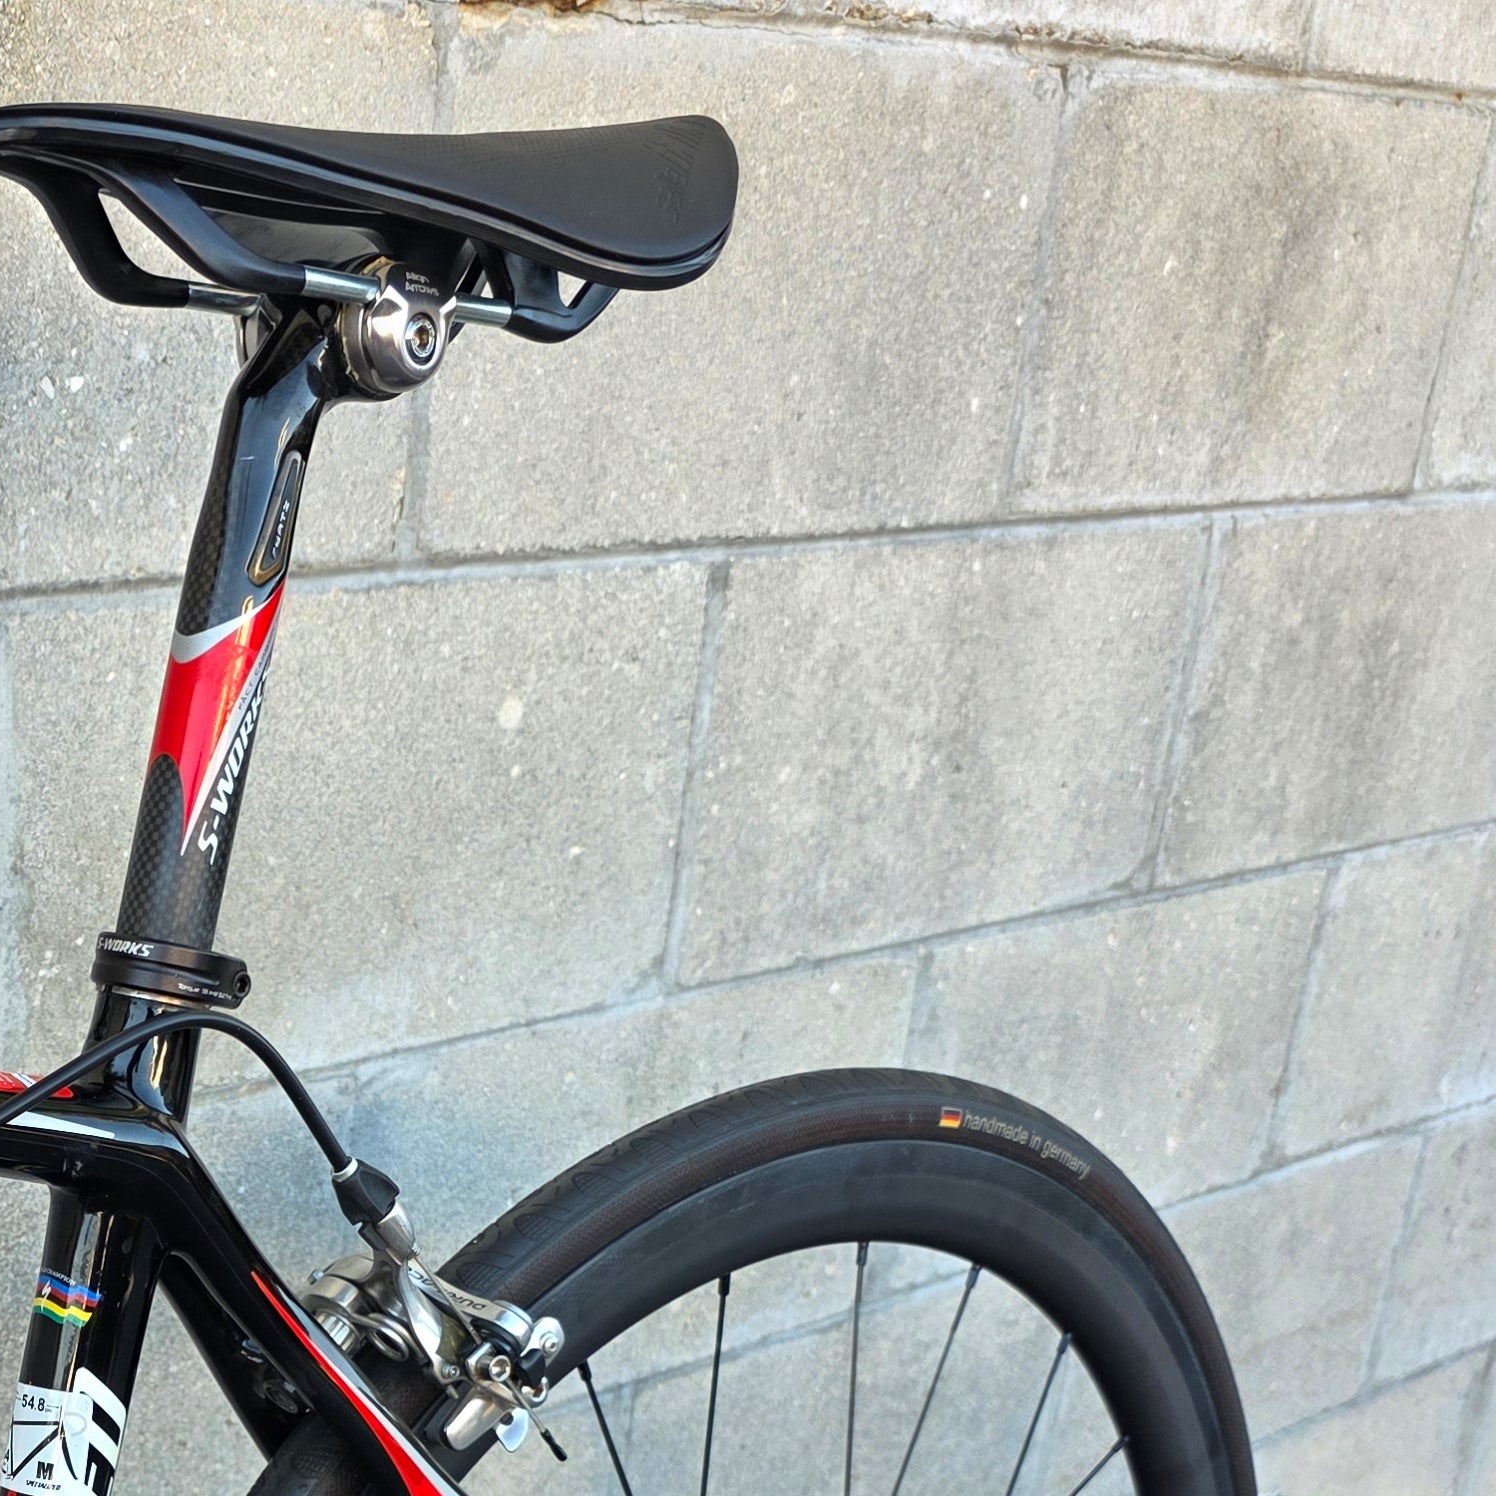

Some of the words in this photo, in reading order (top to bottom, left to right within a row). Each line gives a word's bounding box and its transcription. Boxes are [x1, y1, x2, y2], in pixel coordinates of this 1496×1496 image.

[98, 937, 154, 957] S-WORKS
[963, 1110, 1029, 1145] handmade
[1028, 1130, 1042, 1150] in
[1040, 1141, 1091, 1180] germany
[21, 1393, 45, 1412] 54.8
[36, 1460, 54, 1481] M
